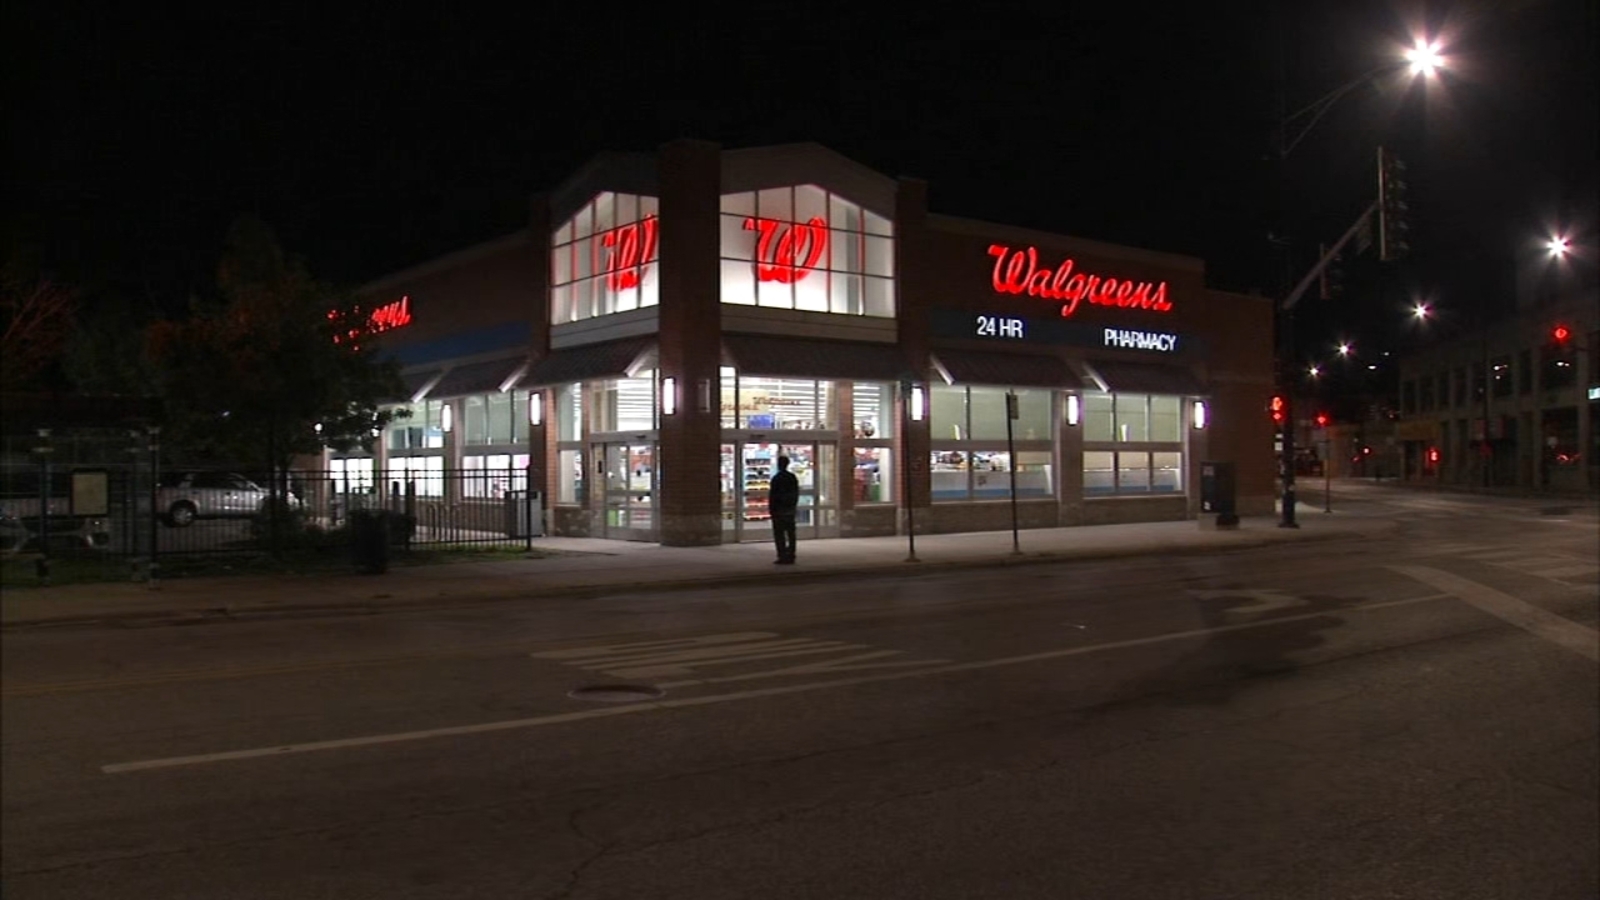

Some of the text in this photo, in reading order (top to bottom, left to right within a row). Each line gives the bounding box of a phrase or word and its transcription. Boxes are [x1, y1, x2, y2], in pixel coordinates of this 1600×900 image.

[744, 216, 828, 284] W
[987, 244, 1173, 317] Walgreens
[976, 315, 1177, 351] 24 HR PHARMACY
